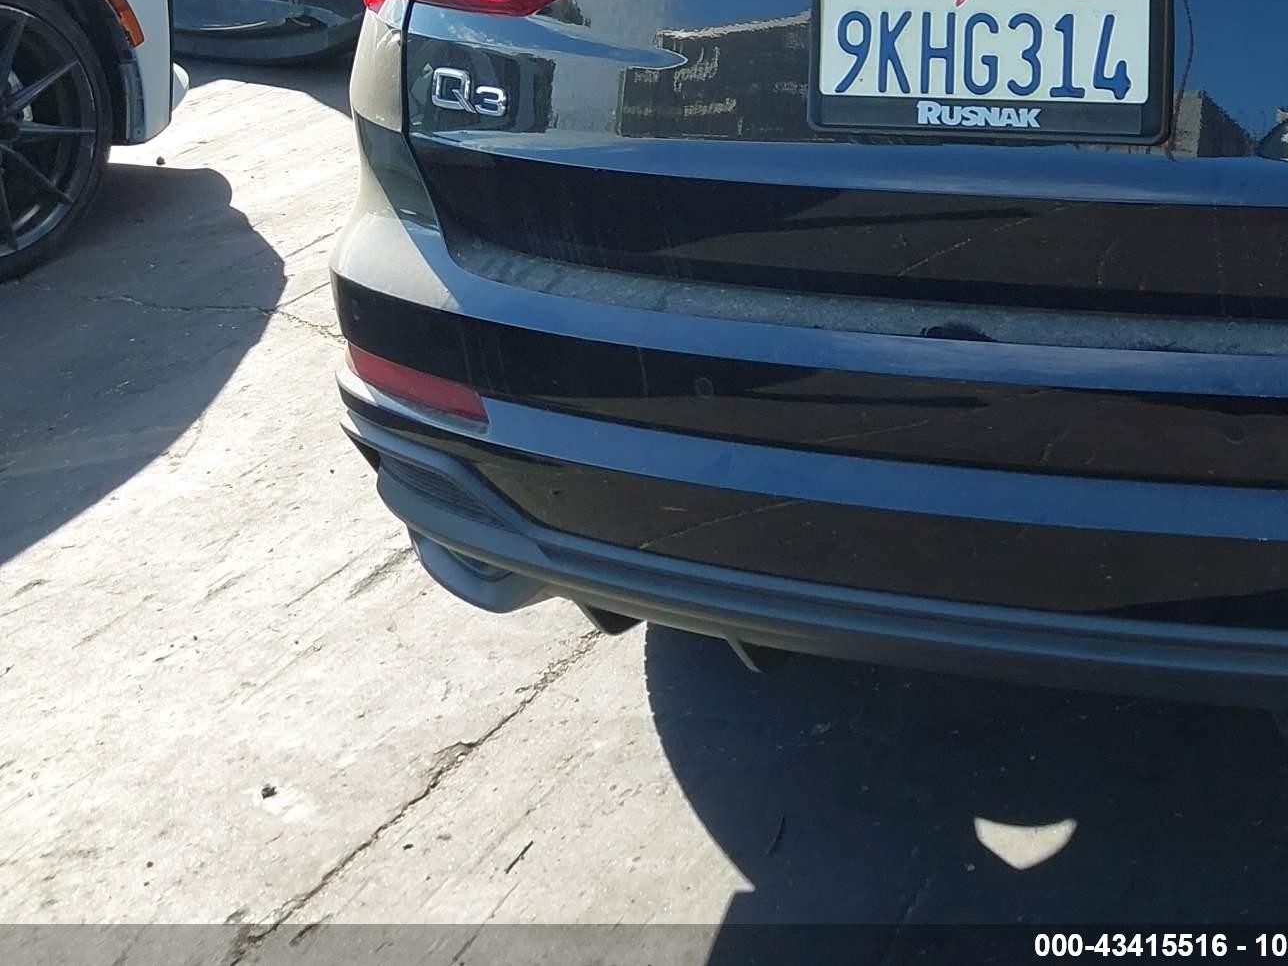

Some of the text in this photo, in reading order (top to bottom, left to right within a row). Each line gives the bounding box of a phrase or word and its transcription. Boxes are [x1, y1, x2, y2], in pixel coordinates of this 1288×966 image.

[834, 10, 1132, 100] 9KHG314
[431, 67, 506, 117] Q3
[916, 100, 1042, 128] RUSNAK
